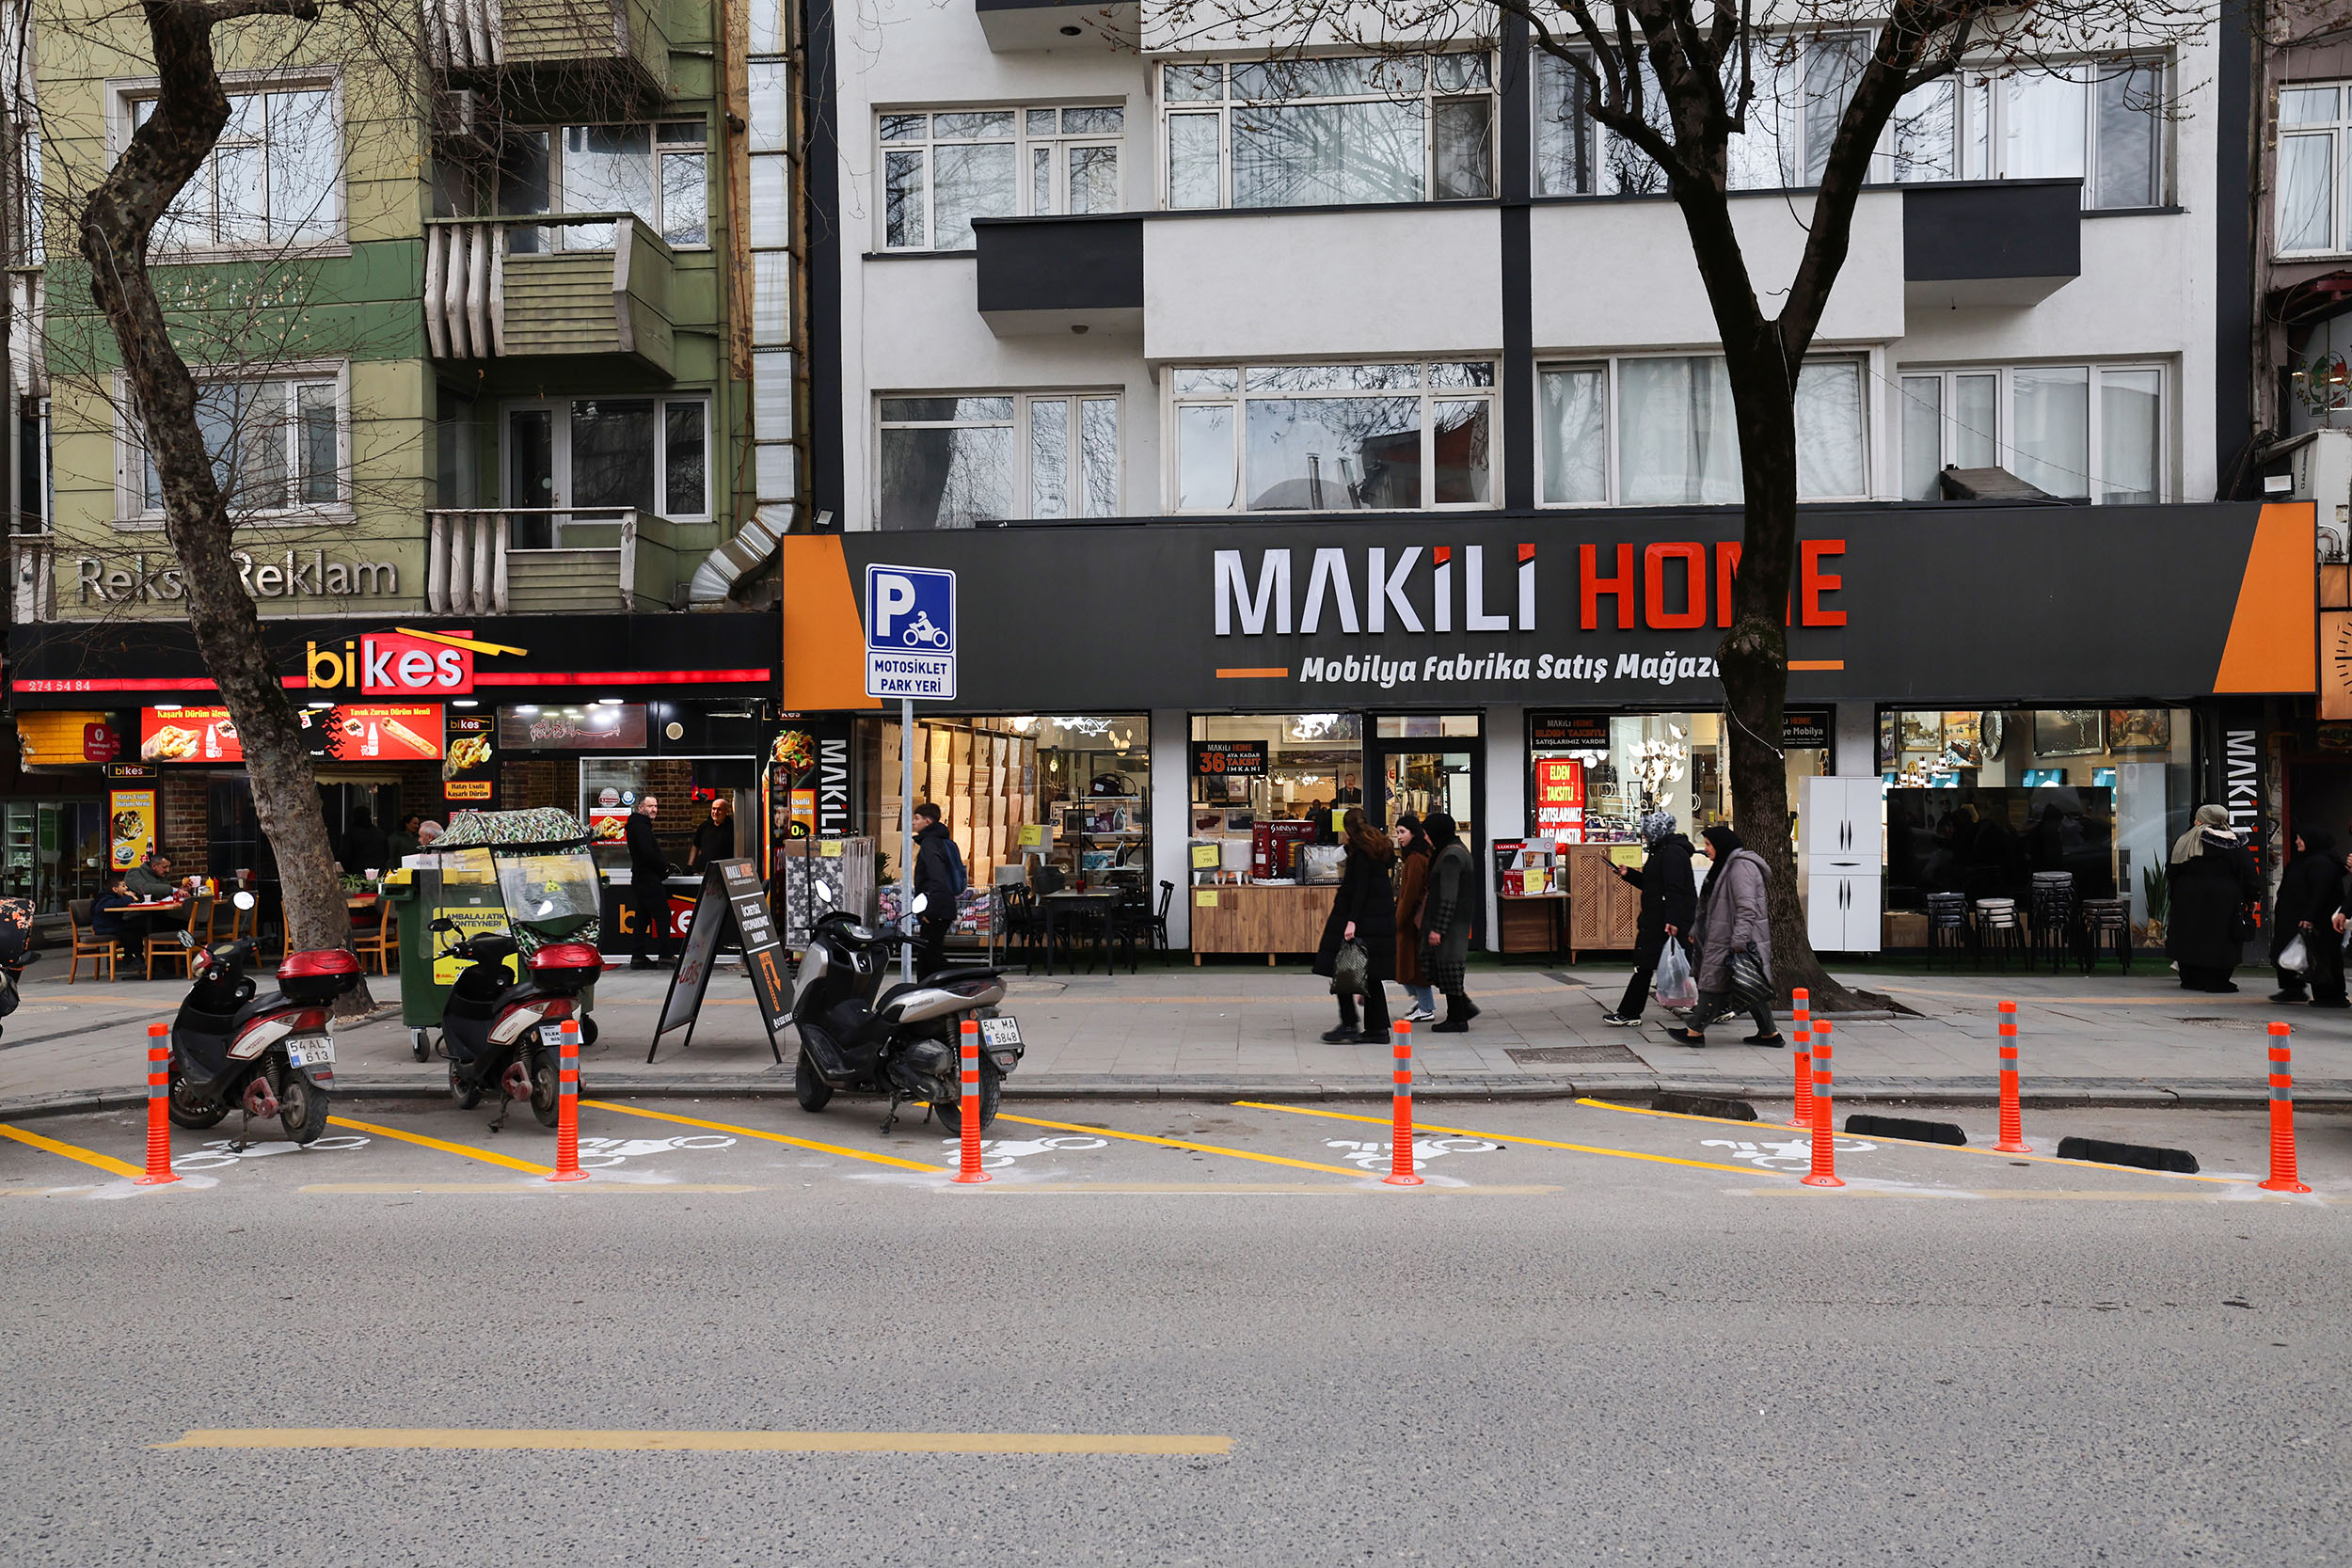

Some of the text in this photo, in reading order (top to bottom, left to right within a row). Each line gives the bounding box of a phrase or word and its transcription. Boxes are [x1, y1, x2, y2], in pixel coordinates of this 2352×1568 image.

[76, 549, 397, 603] Reks Reklam
[1214, 544, 1536, 635] MAKİLİ
[877, 573, 916, 637] P
[307, 640, 463, 689] bikes
[875, 659, 947, 675] MOTOSİKLET
[1299, 655, 1417, 689] Mobilya
[1422, 652, 1531, 682] Fabrika
[1536, 654, 1609, 684] Satış
[29, 680, 91, 691] 274 54 84
[881, 678, 941, 693] PARK YERİ
[184, 709, 210, 718] Dürüm
[450, 719, 480, 729] bikes
[1793, 727, 1823, 736] Mobilya
[1200, 752, 1226, 773] 36
[115, 767, 144, 775] bikes
[1549, 765, 1571, 781] ELDEN
[820, 739, 847, 834] MAKİLİ
[1546, 782, 1575, 801] TAKSİTLİ
[1538, 806, 1583, 827] SATIŞLARIMIZ
[983, 1019, 1015, 1032] 54 MA
[290, 1037, 332, 1053] 54 ALT
[995, 1031, 1018, 1043] 5848
[306, 1051, 329, 1063] 613
